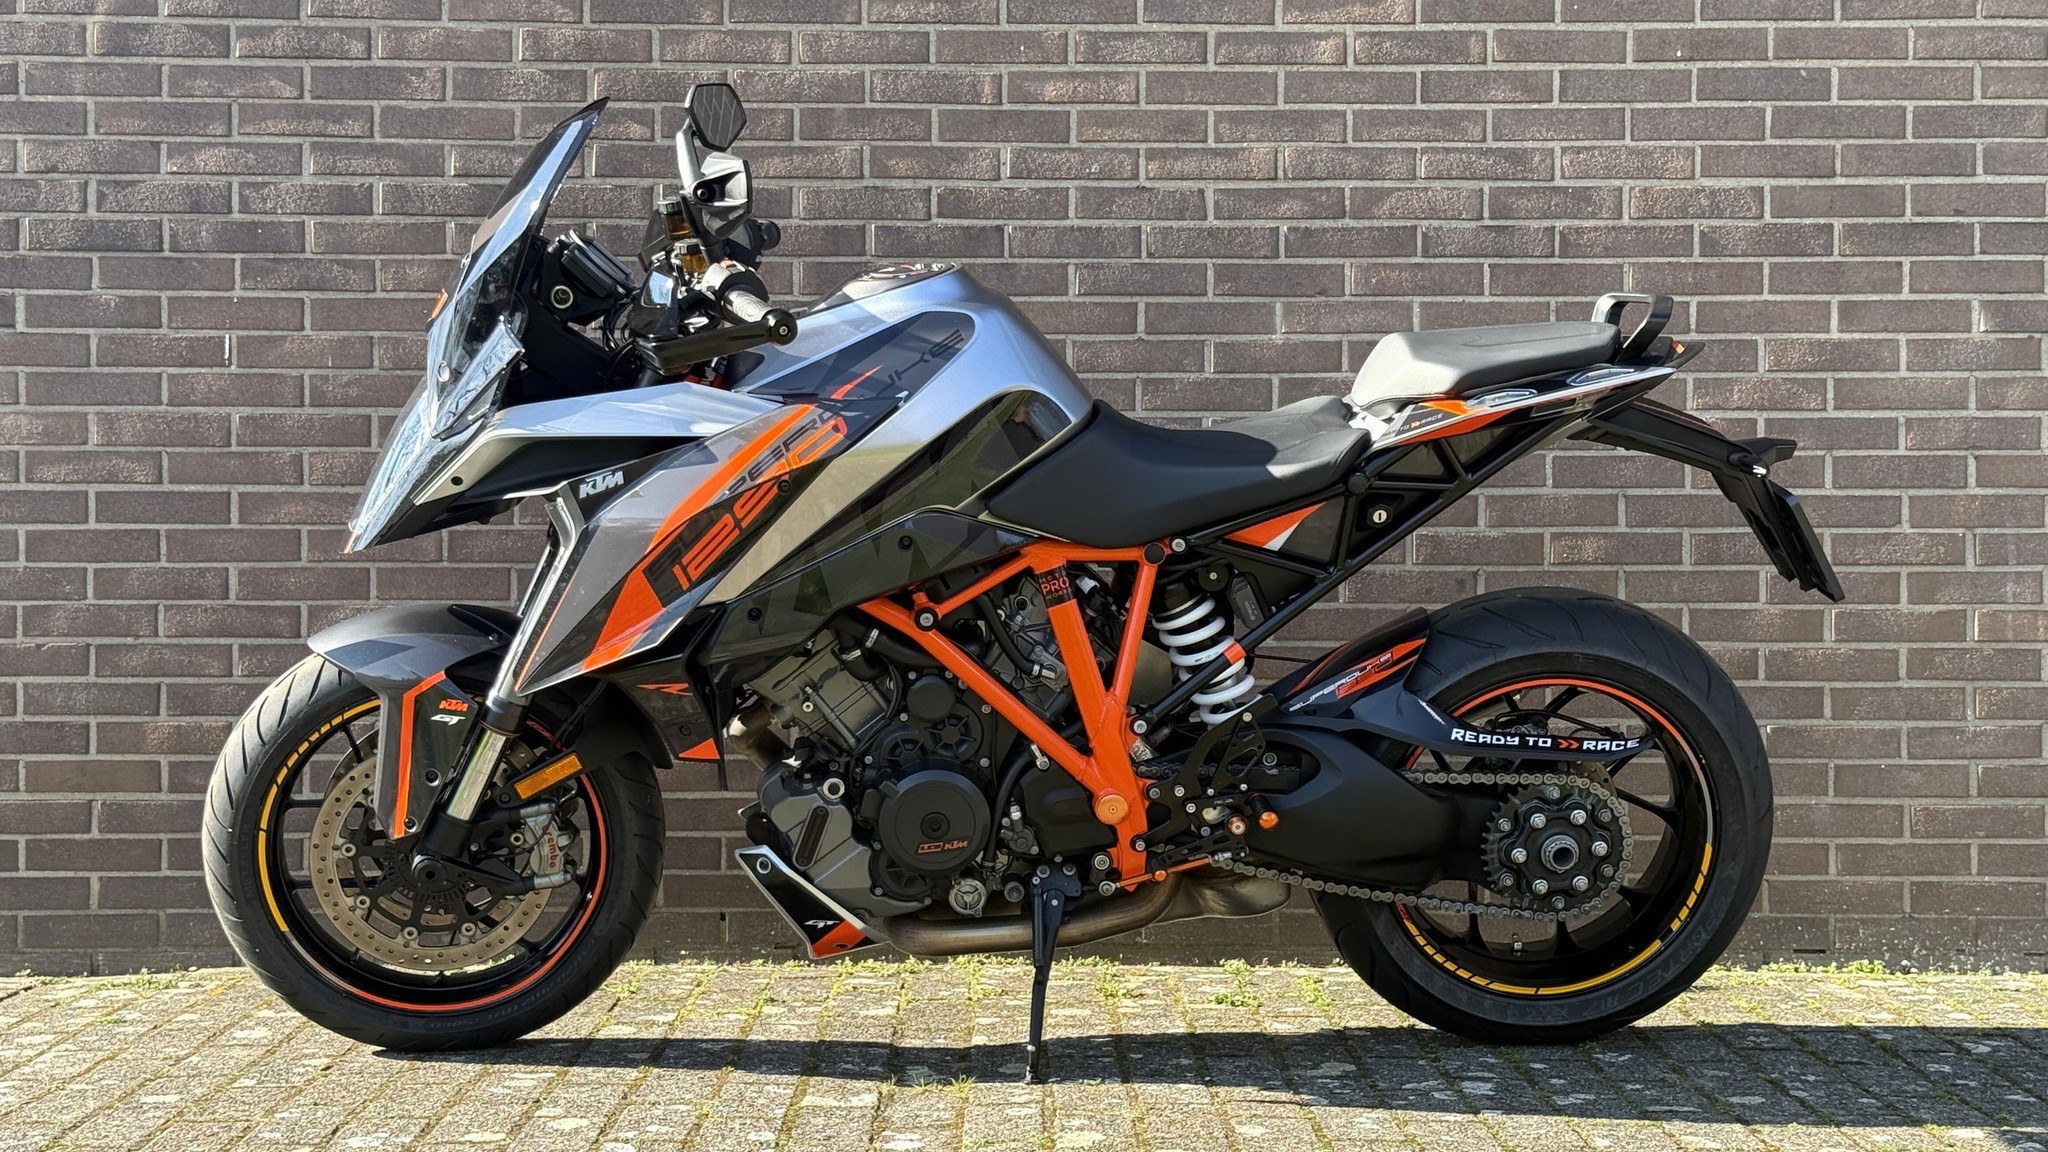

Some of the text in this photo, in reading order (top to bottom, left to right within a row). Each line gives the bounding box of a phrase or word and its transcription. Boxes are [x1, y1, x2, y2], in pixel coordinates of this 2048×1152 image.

[579, 470, 624, 499] KTM
[1041, 576, 1070, 596] PRO
[439, 698, 469, 712] KTM
[431, 714, 466, 726] GT
[1451, 728, 1641, 751] READY TO RACE
[943, 840, 969, 850] KTM
